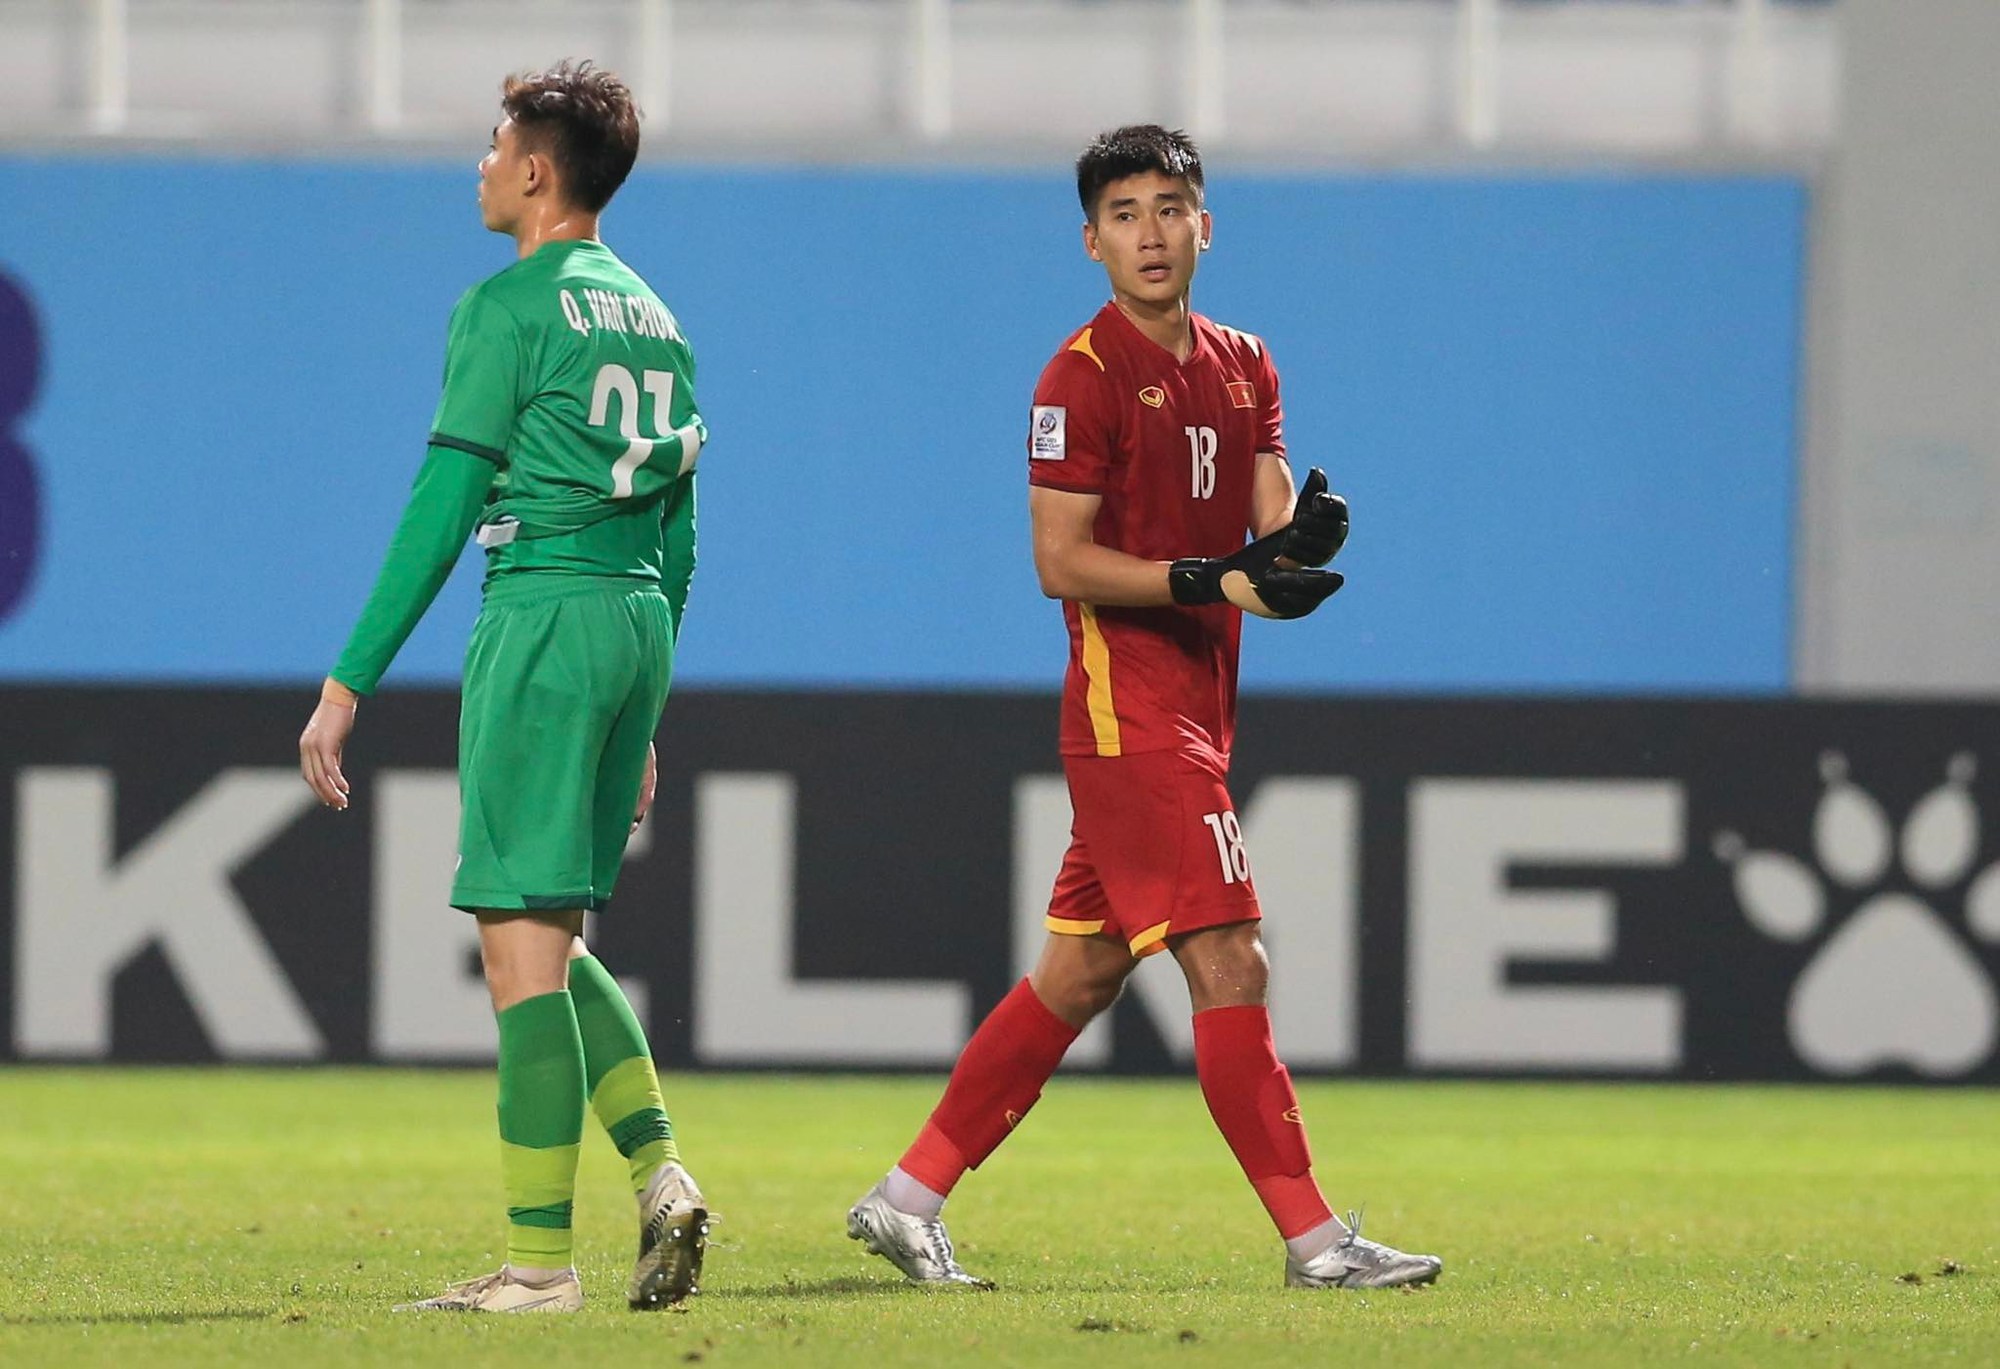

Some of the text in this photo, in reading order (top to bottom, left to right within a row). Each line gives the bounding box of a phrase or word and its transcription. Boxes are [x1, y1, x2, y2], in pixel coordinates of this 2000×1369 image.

[560, 288, 592, 338] Q.
[1184, 426, 1218, 500] 18
[1203, 810, 1249, 884] 18
